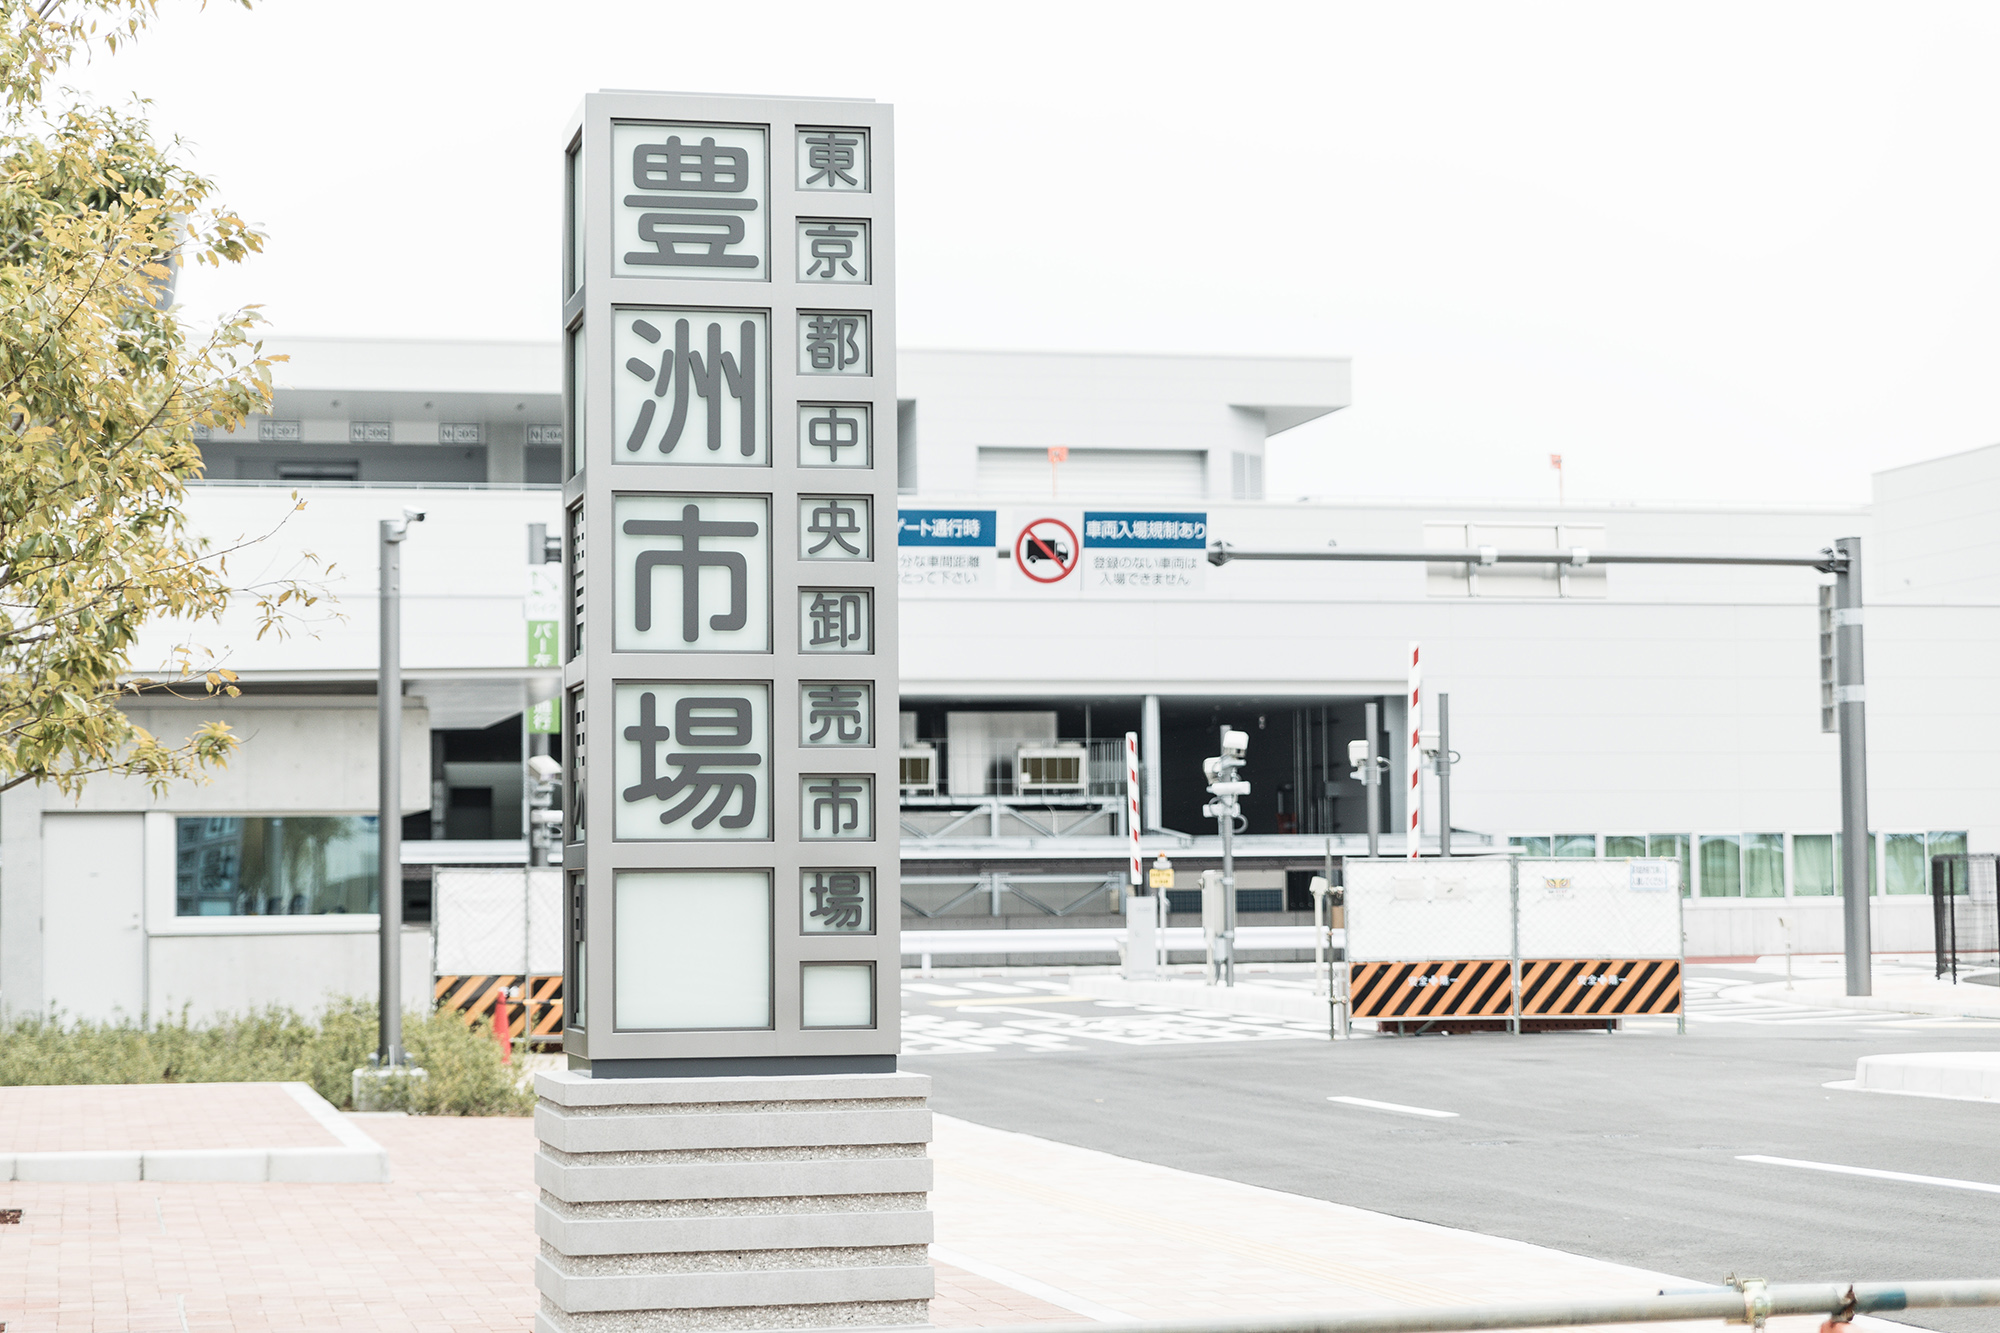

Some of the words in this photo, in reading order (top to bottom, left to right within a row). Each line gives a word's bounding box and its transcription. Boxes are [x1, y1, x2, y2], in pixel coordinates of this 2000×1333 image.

[622, 135, 762, 830] 豊洲市場
[804, 133, 864, 928] 東京都中央卸売市場
[1085, 520, 1206, 540] 車両入場規制あり
[1093, 556, 1197, 569] 登録のない車両は
[898, 571, 977, 584] とって下さい
